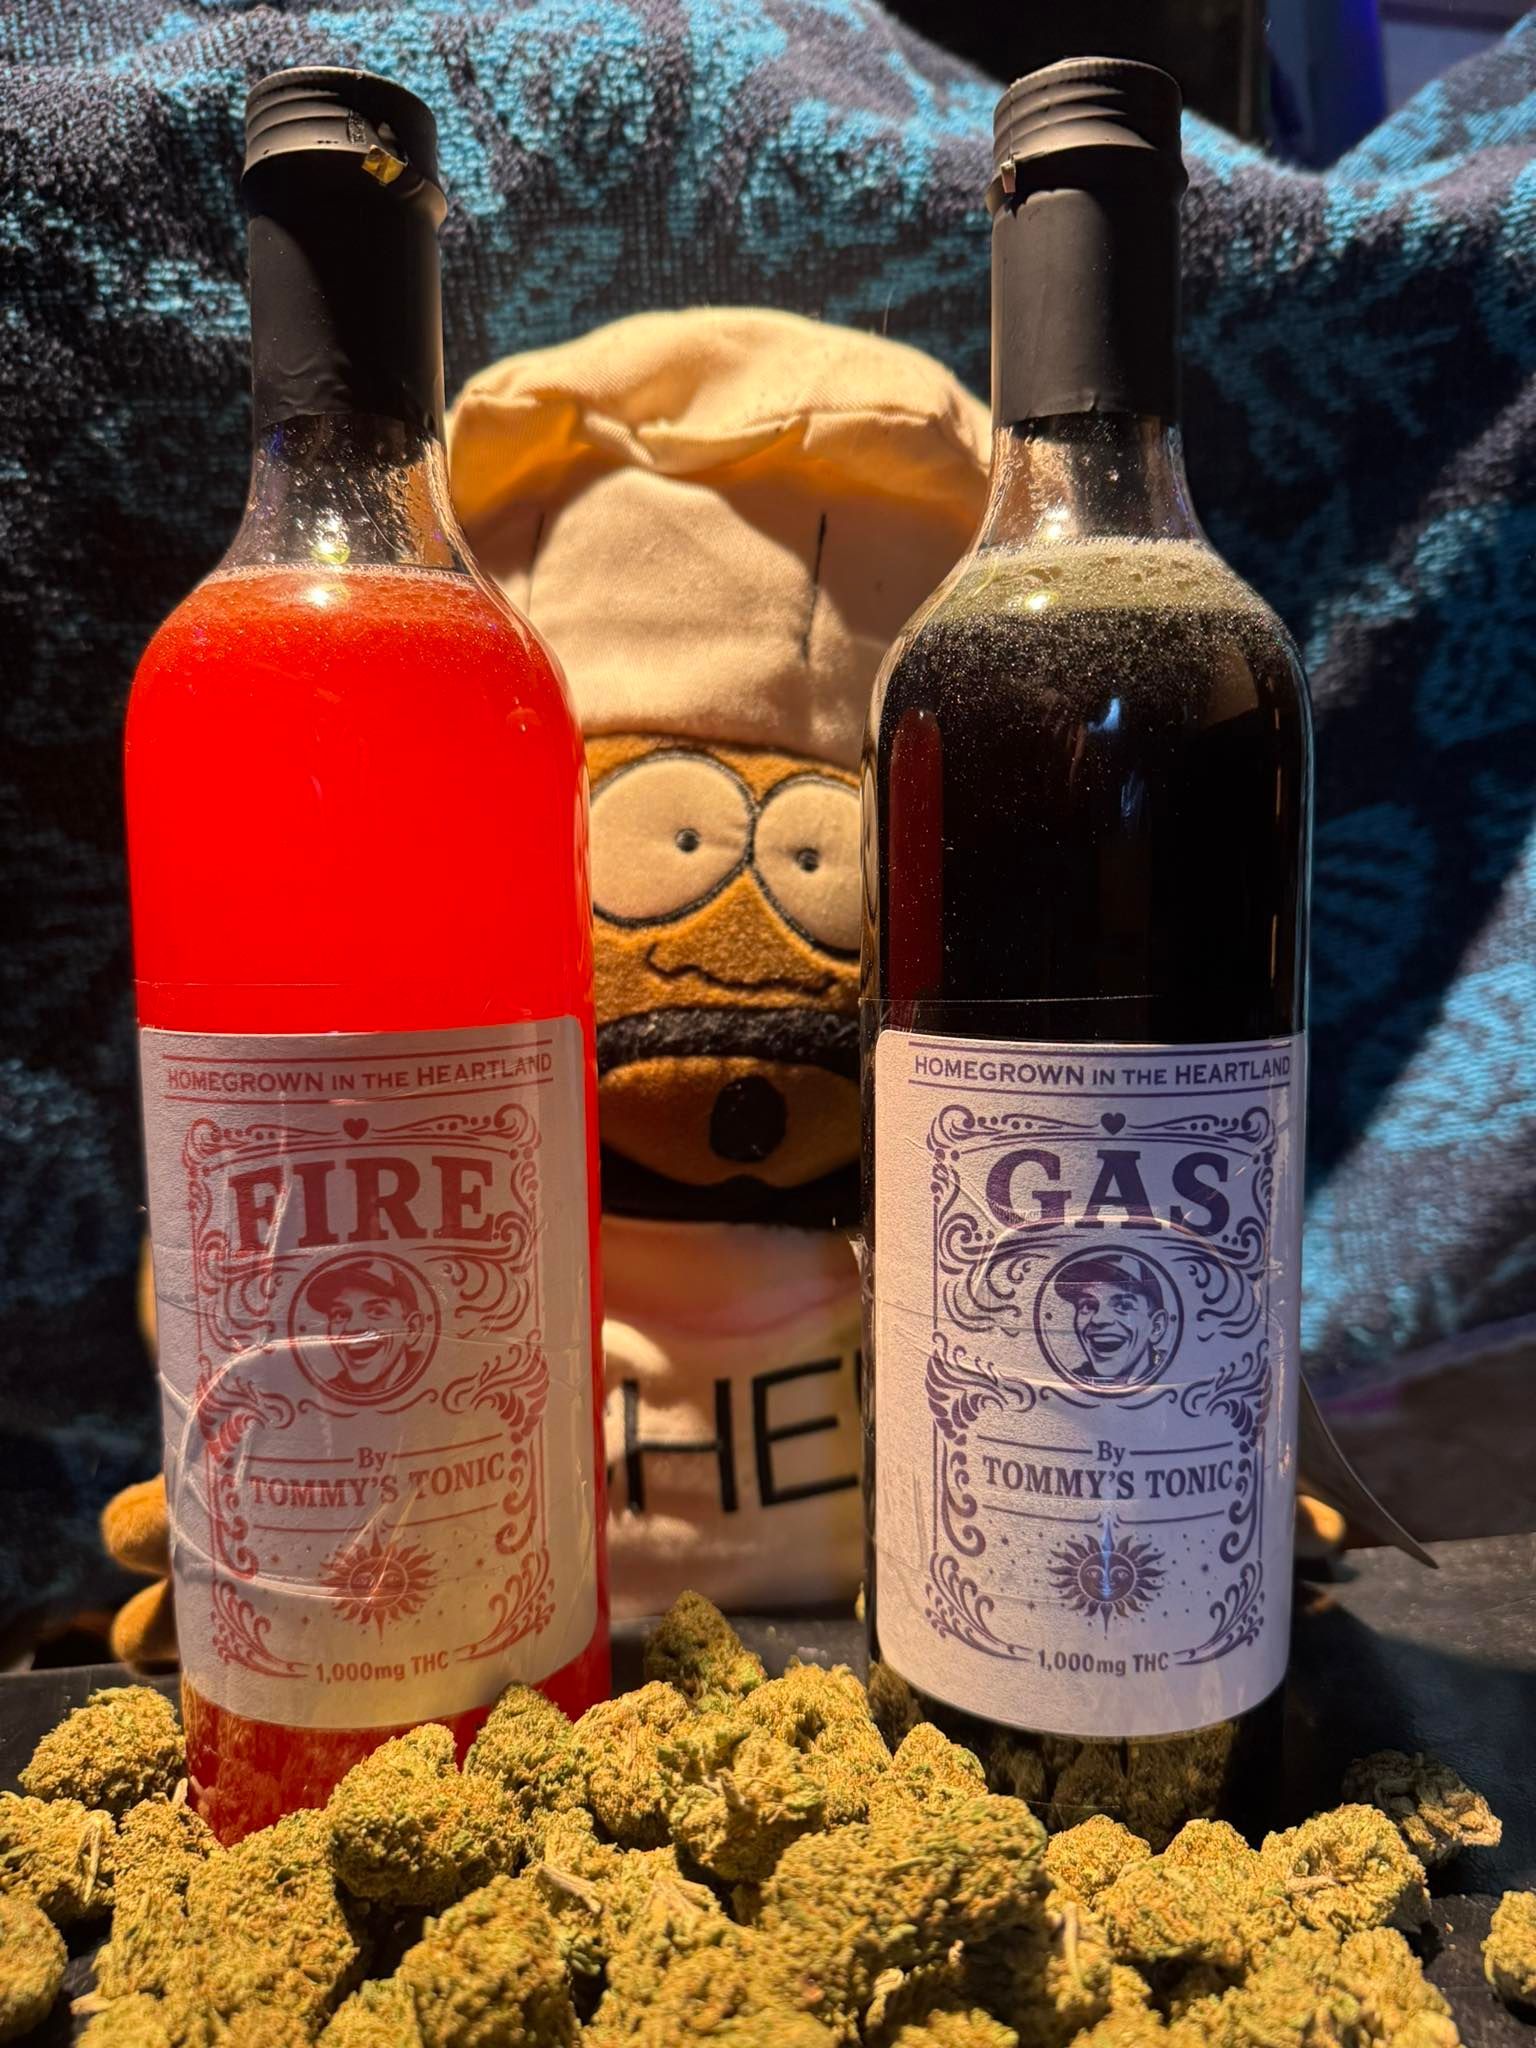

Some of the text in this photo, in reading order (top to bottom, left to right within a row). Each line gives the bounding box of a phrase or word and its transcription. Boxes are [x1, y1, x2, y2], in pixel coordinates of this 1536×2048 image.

[167, 1053, 552, 1093] HOMEGROWN IN THE HEARTLAND
[915, 1055, 1291, 1086] HOMEGROWN IN THE HEARTLAND
[227, 1155, 497, 1254] FIRE
[985, 1148, 1231, 1237] GAS
[606, 1350, 863, 1513] HE
[357, 1446, 388, 1472] By
[1096, 1440, 1126, 1467] By
[249, 1452, 505, 1509] TOMMY’S TONIC
[982, 1455, 1233, 1500] TOMMY’S TONIC
[315, 1650, 449, 1684] 1,000mg THC
[1038, 1650, 1170, 1677] 1,000mg THC
